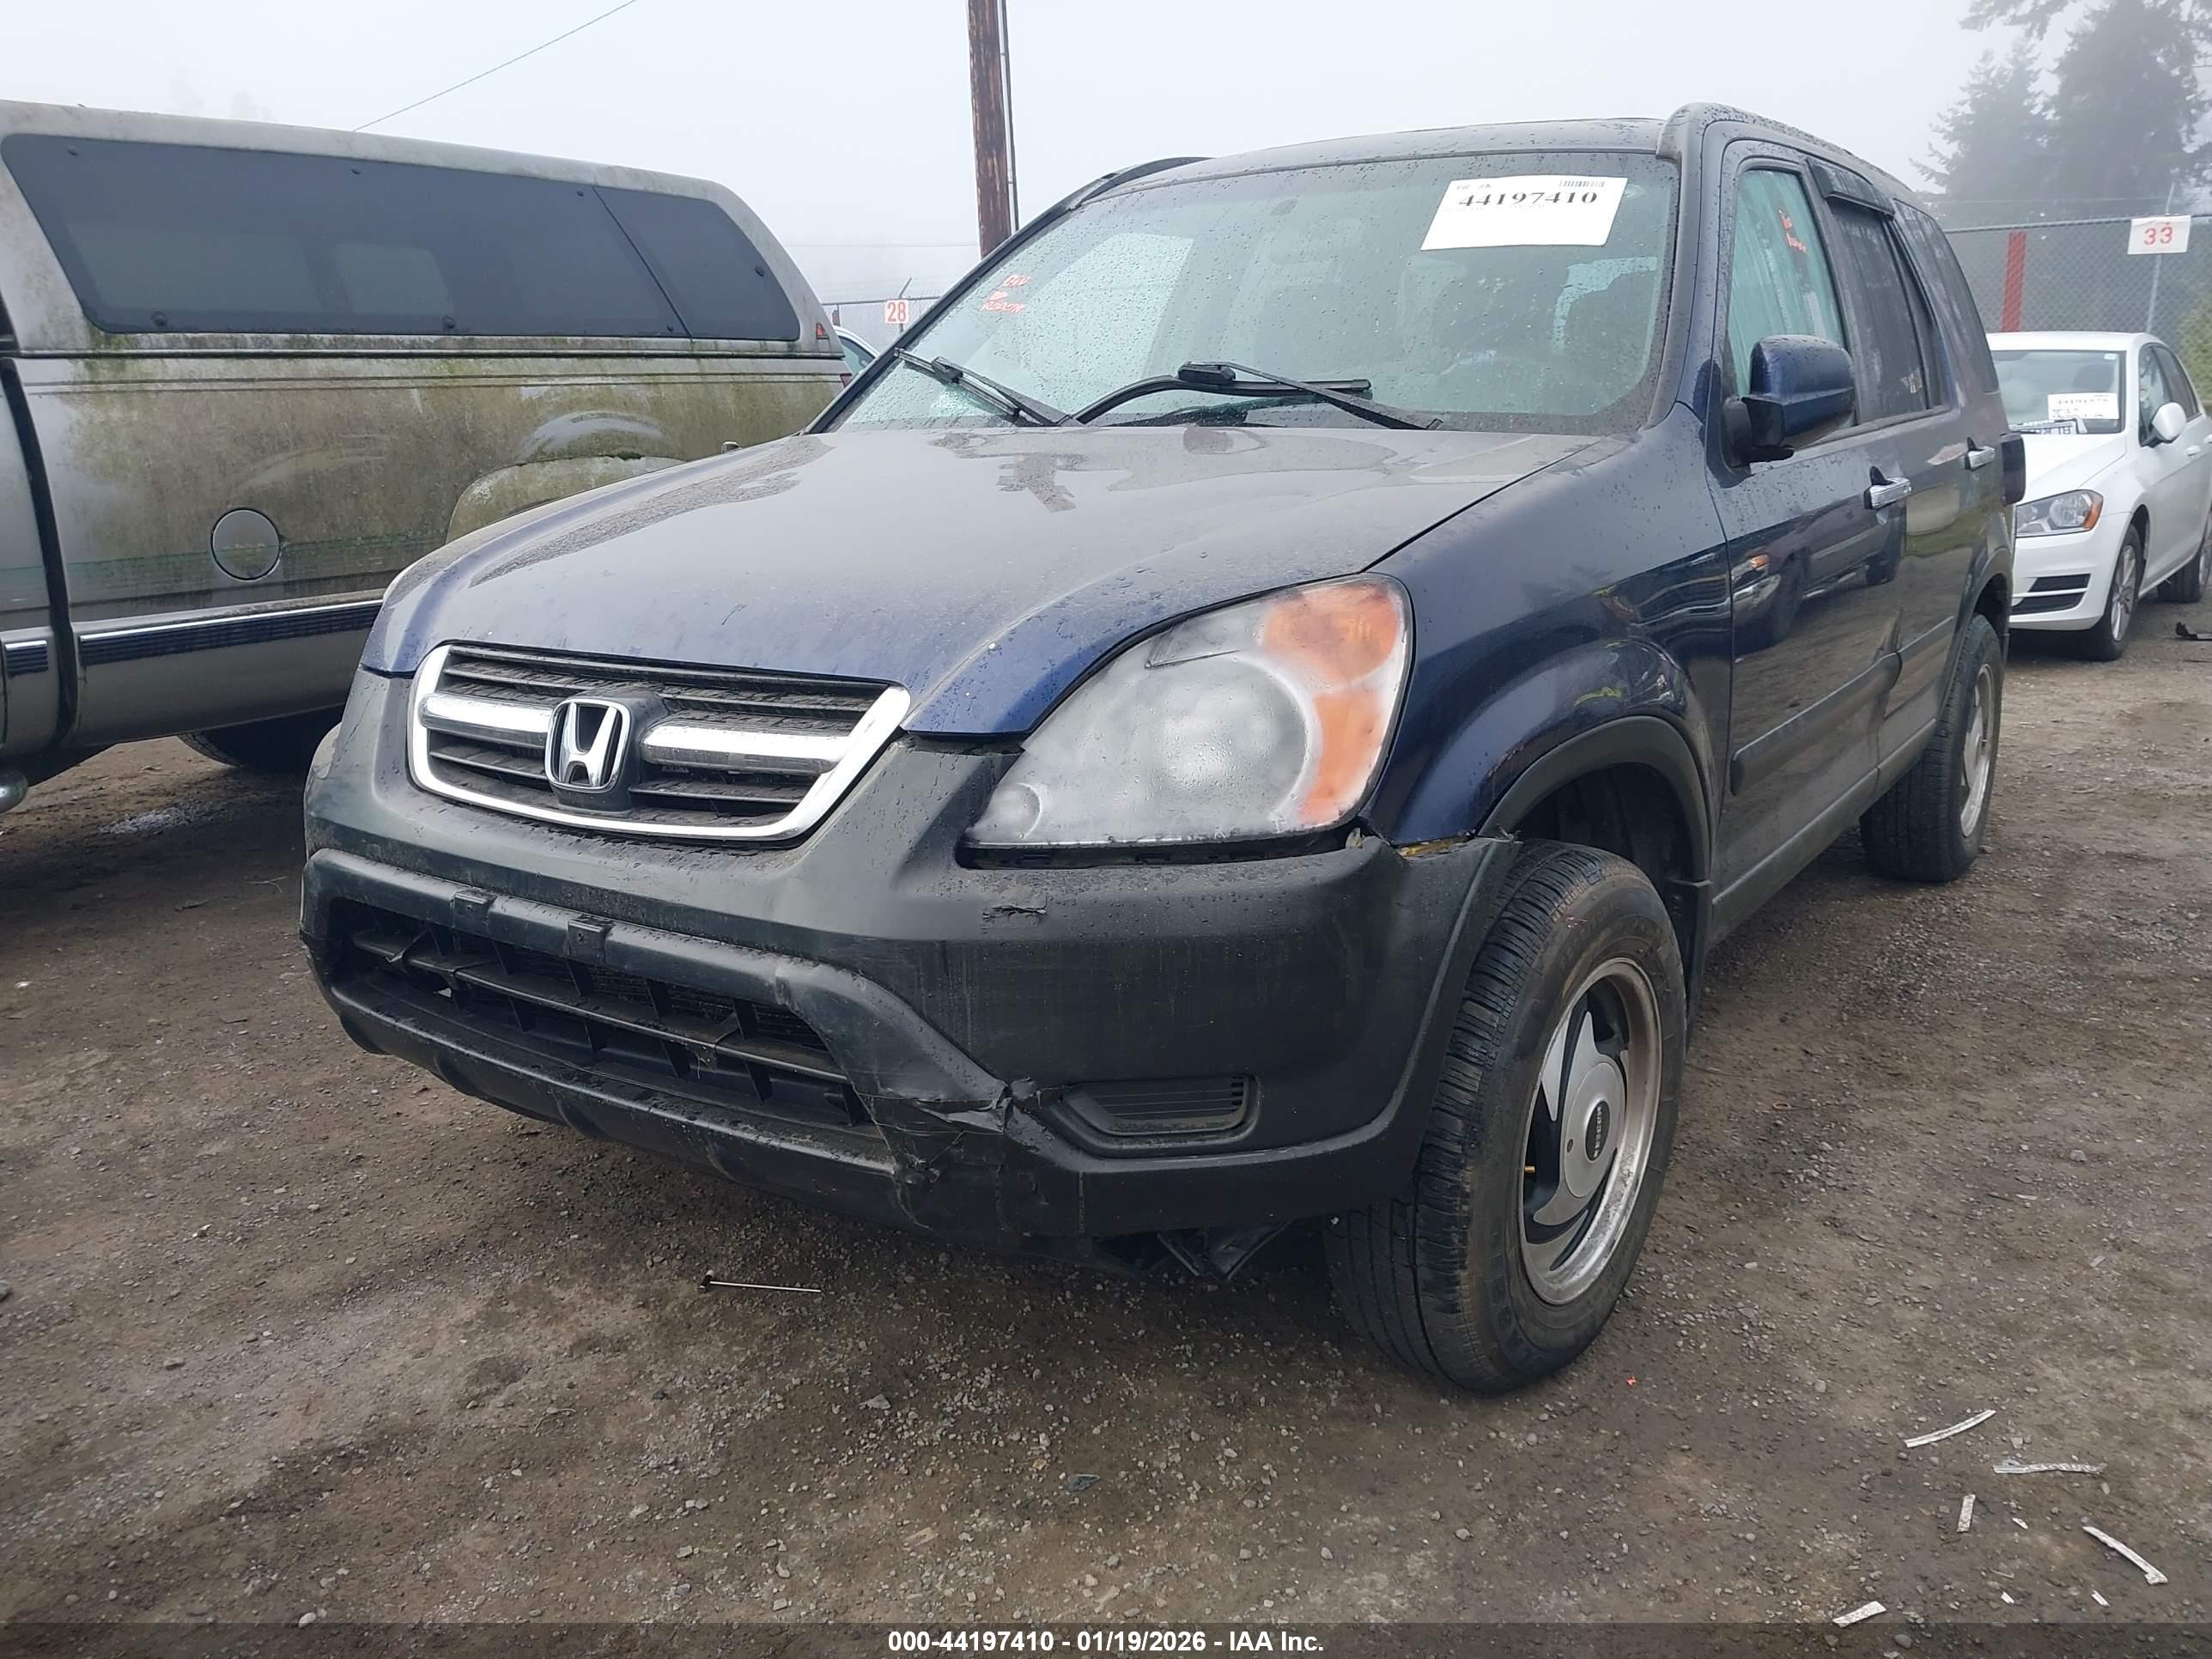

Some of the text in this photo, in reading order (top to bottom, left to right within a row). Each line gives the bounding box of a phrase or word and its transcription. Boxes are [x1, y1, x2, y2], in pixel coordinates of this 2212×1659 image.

[1458, 191, 1598, 208] 44197410
[2143, 226, 2173, 246] 33
[887, 301, 907, 322] 28
